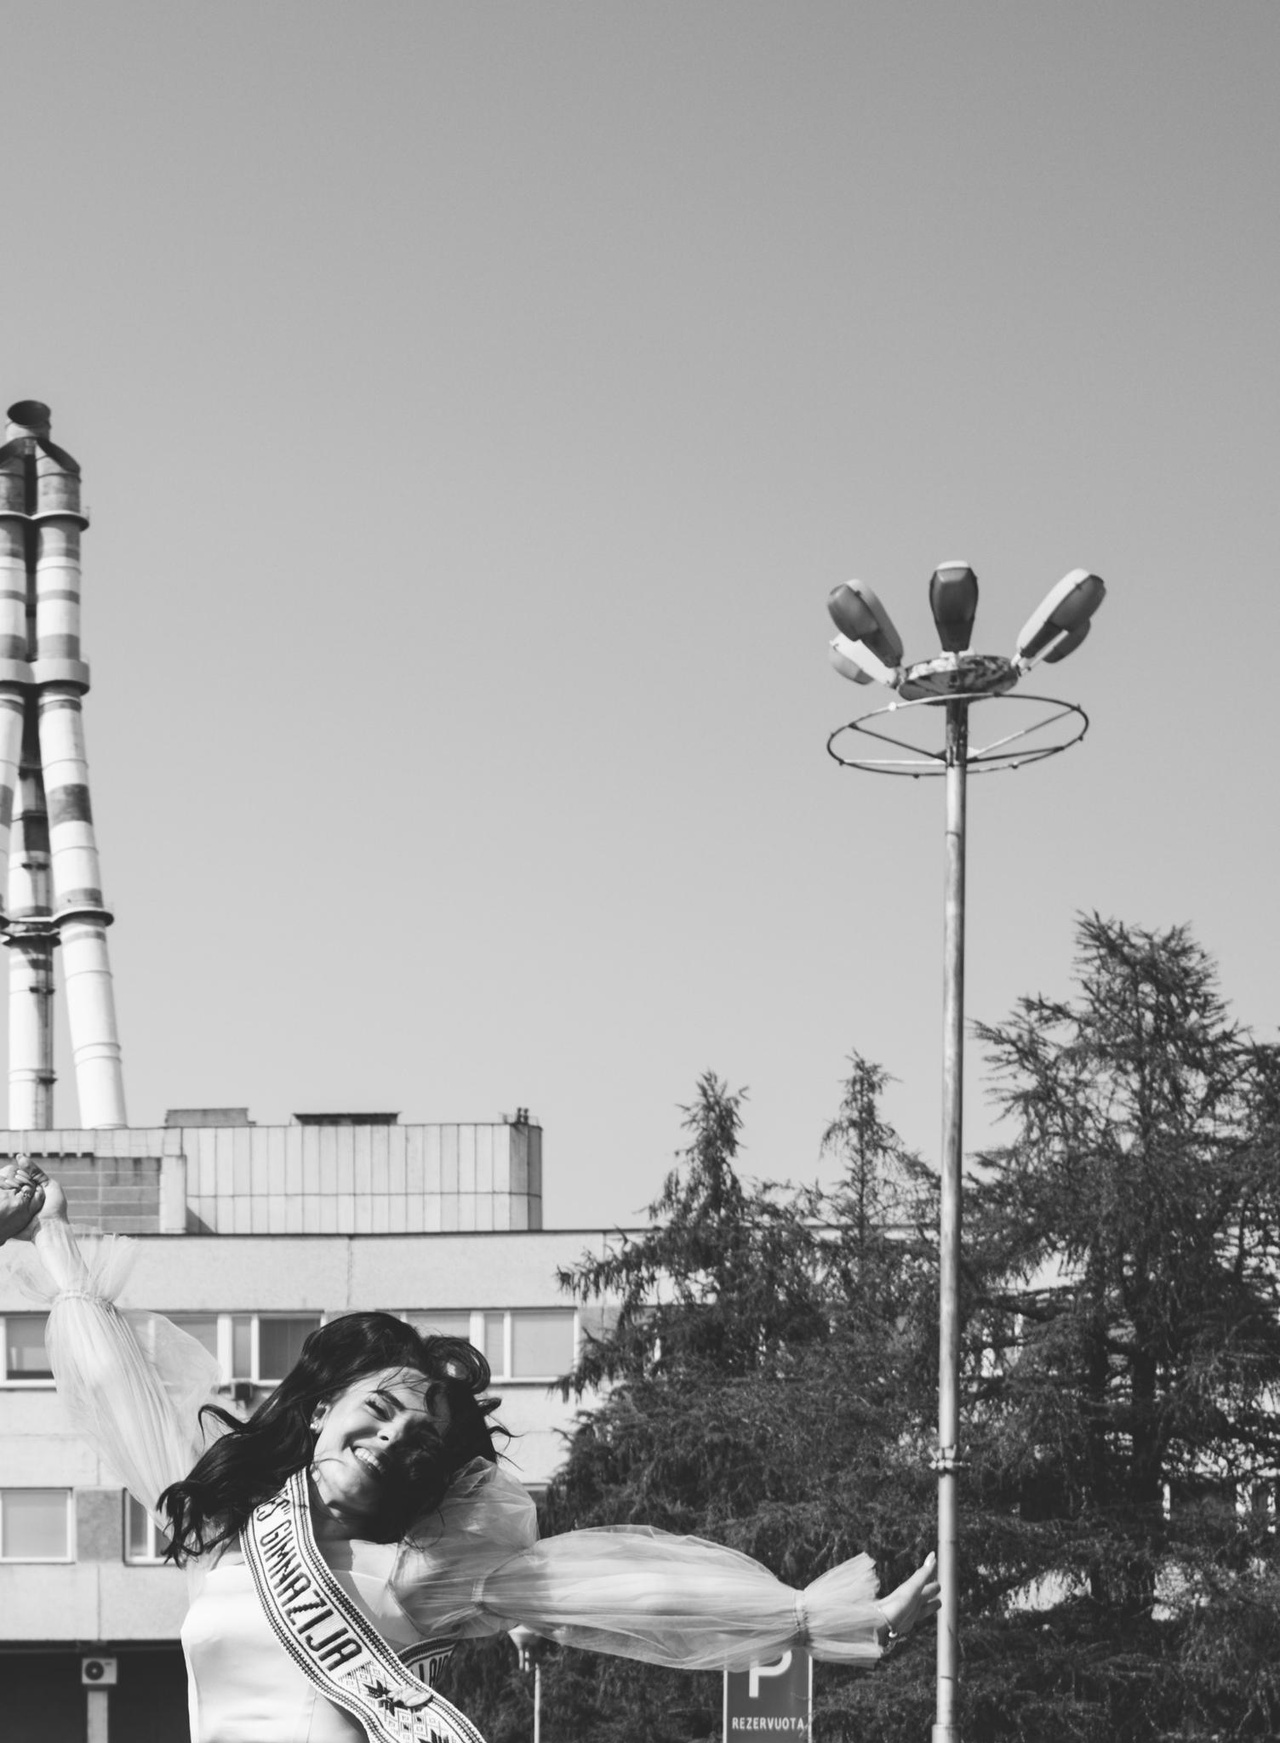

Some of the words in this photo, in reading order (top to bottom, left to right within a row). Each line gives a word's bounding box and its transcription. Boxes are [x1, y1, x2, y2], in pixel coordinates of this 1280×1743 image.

[260, 1519, 363, 1672] GIMNAZIJA
[748, 1649, 793, 1698] P
[731, 1716, 805, 1731] REZERVUOTA
